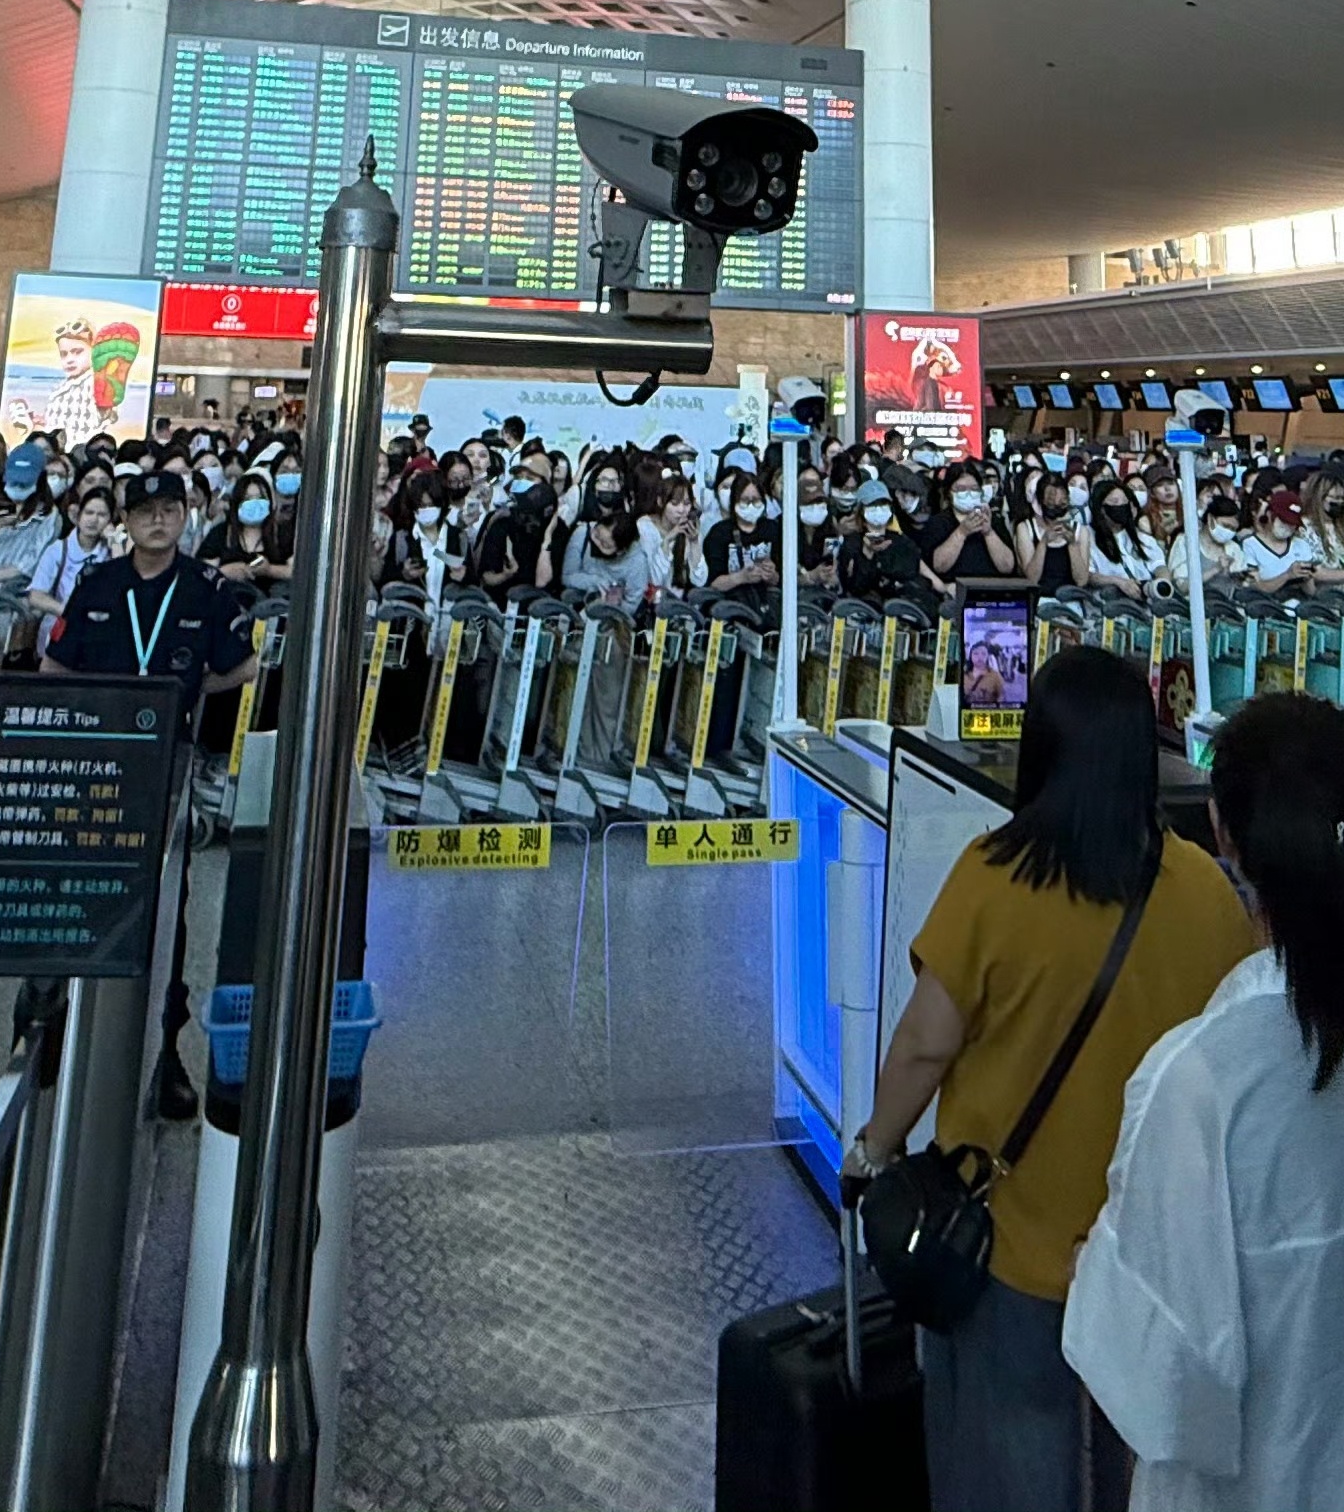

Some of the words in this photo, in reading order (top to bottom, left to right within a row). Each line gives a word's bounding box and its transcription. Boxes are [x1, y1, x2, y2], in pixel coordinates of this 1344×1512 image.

[419, 25, 500, 50] 出发信息
[505, 38, 570, 56] Departure
[572, 45, 645, 62] Information
[1315, 388, 1331, 400] F21
[3, 706, 70, 726] 温馨提示
[73, 711, 101, 727] Tips
[396, 826, 542, 853] 防爆检测
[655, 821, 792, 849] 单人通行
[399, 854, 469, 868] Explosive
[472, 852, 539, 865] detecting
[687, 848, 728, 862] Single
[731, 848, 762, 860] pass
